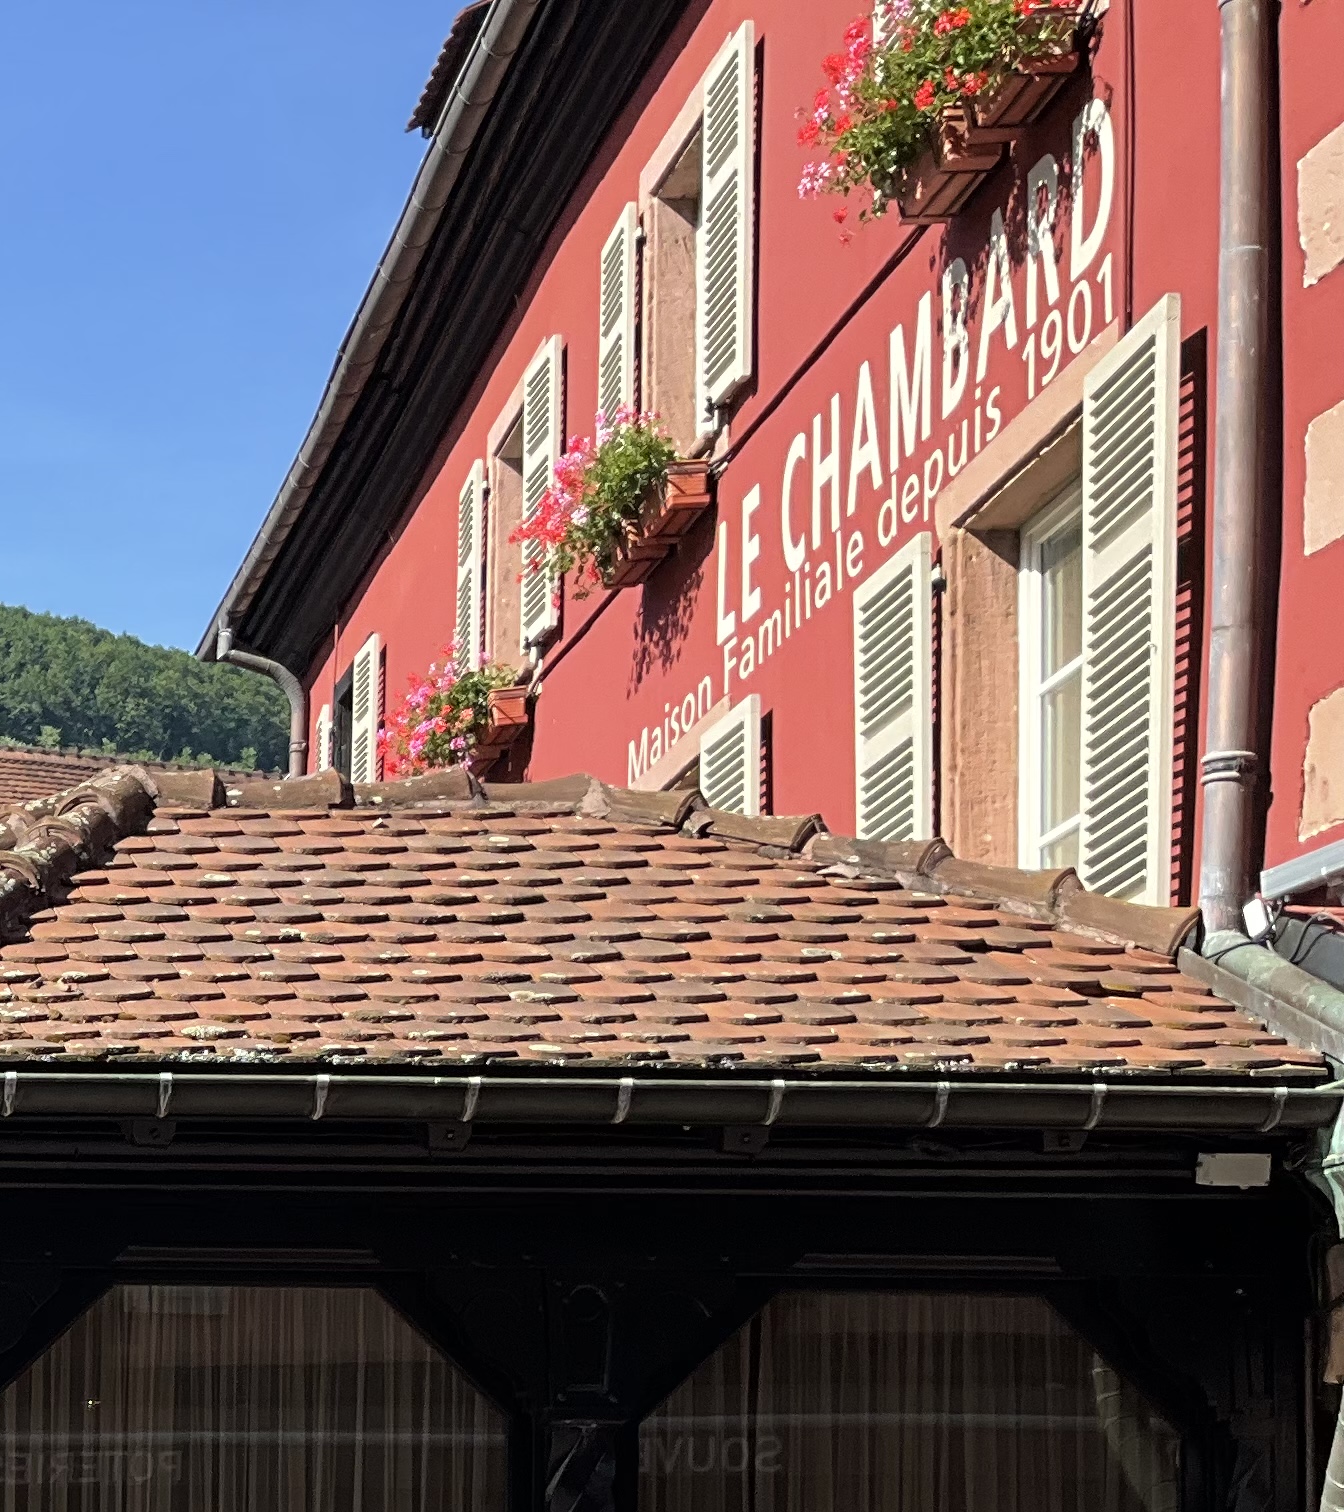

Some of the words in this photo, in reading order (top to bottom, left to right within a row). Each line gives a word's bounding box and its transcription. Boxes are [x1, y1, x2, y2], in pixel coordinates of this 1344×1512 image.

[627, 674, 712, 788] Maison
[723, 530, 864, 695] Familiale
[877, 386, 1000, 547] depuis
[1022, 252, 1112, 400] 1901
[716, 484, 760, 645] LE
[781, 98, 1113, 571] CHAMBARD
